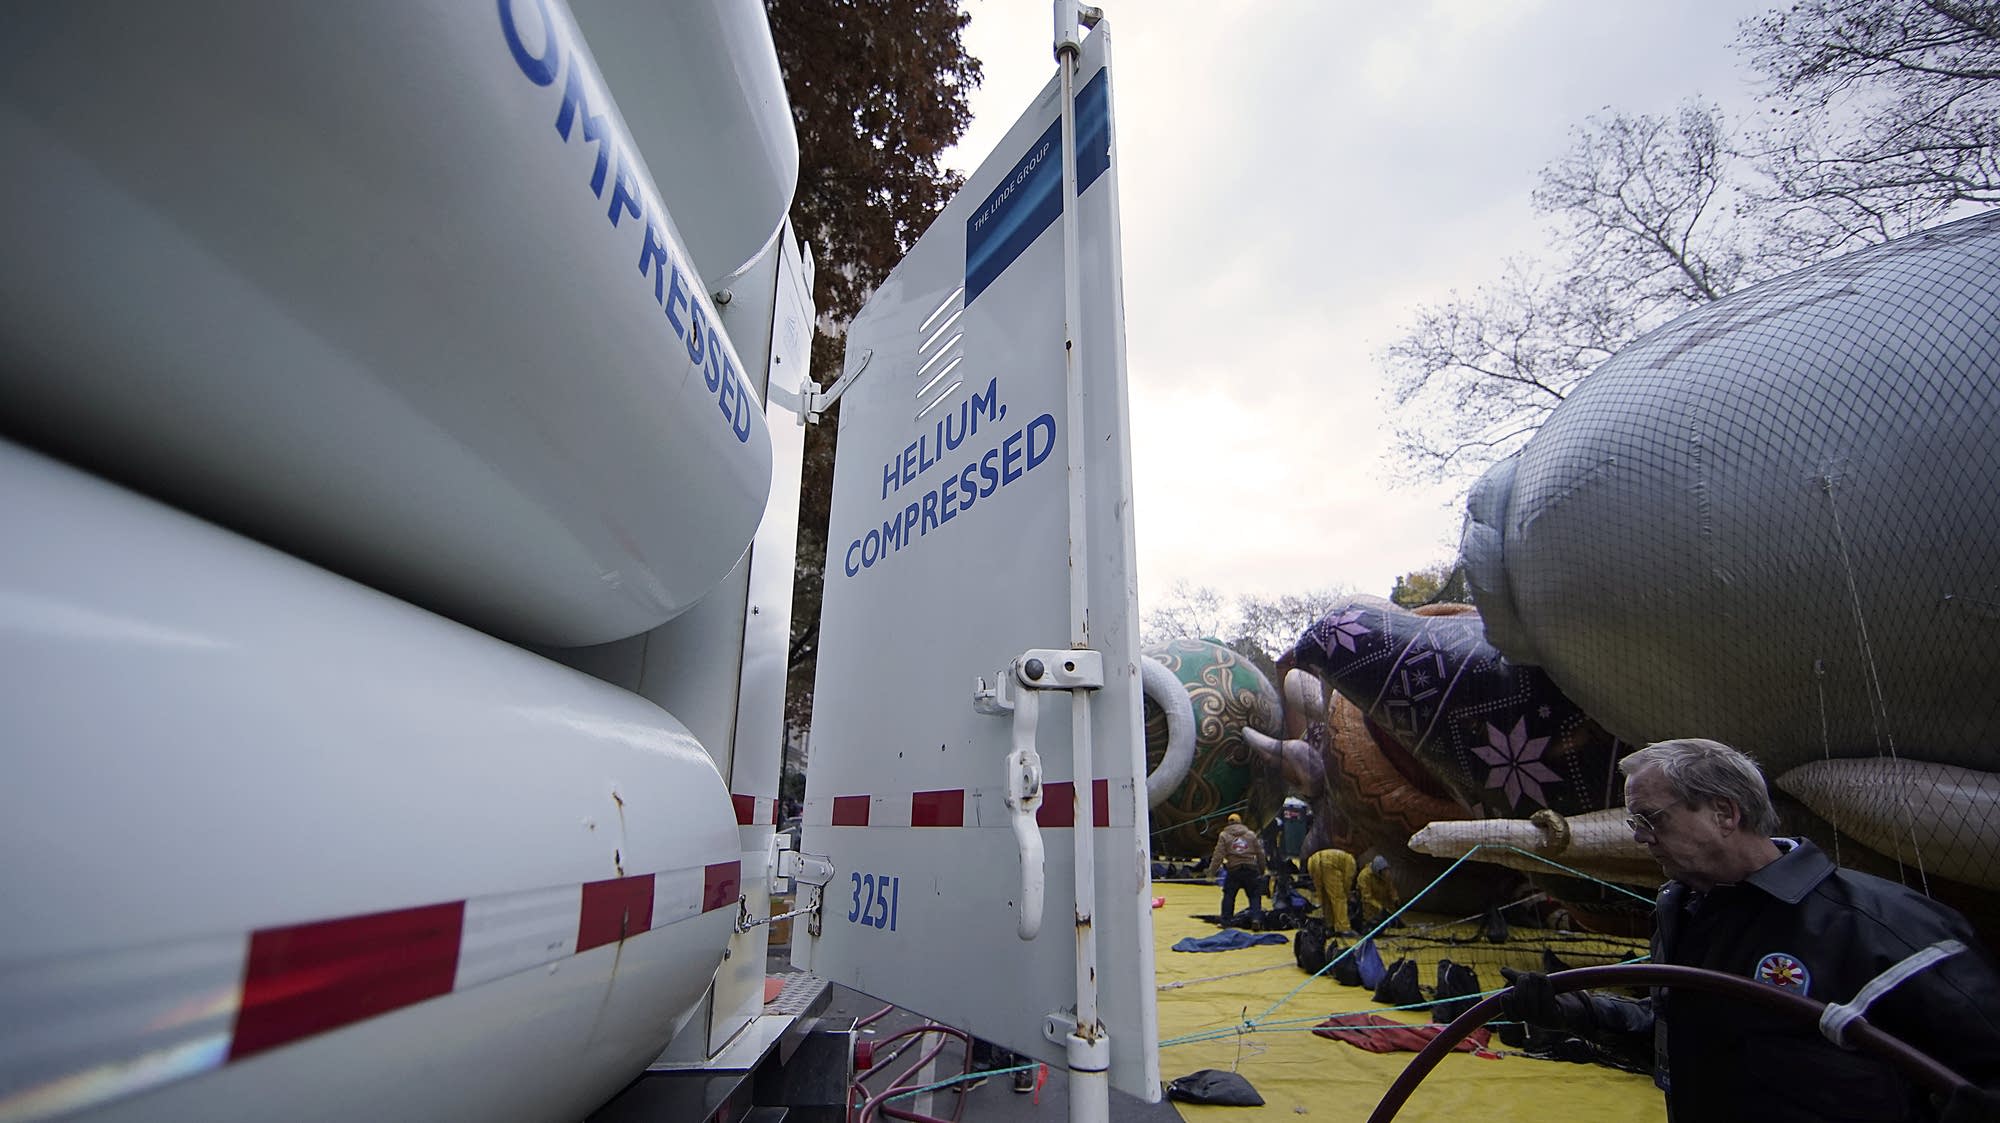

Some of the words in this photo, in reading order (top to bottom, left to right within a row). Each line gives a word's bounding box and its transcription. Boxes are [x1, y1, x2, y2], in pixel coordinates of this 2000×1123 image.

[975, 210, 989, 231] THE
[1016, 142, 1049, 184] GROUP
[882, 377, 1007, 500] HELIUM,
[845, 413, 1056, 577] COMPRESSED
[848, 872, 899, 931] 3251
